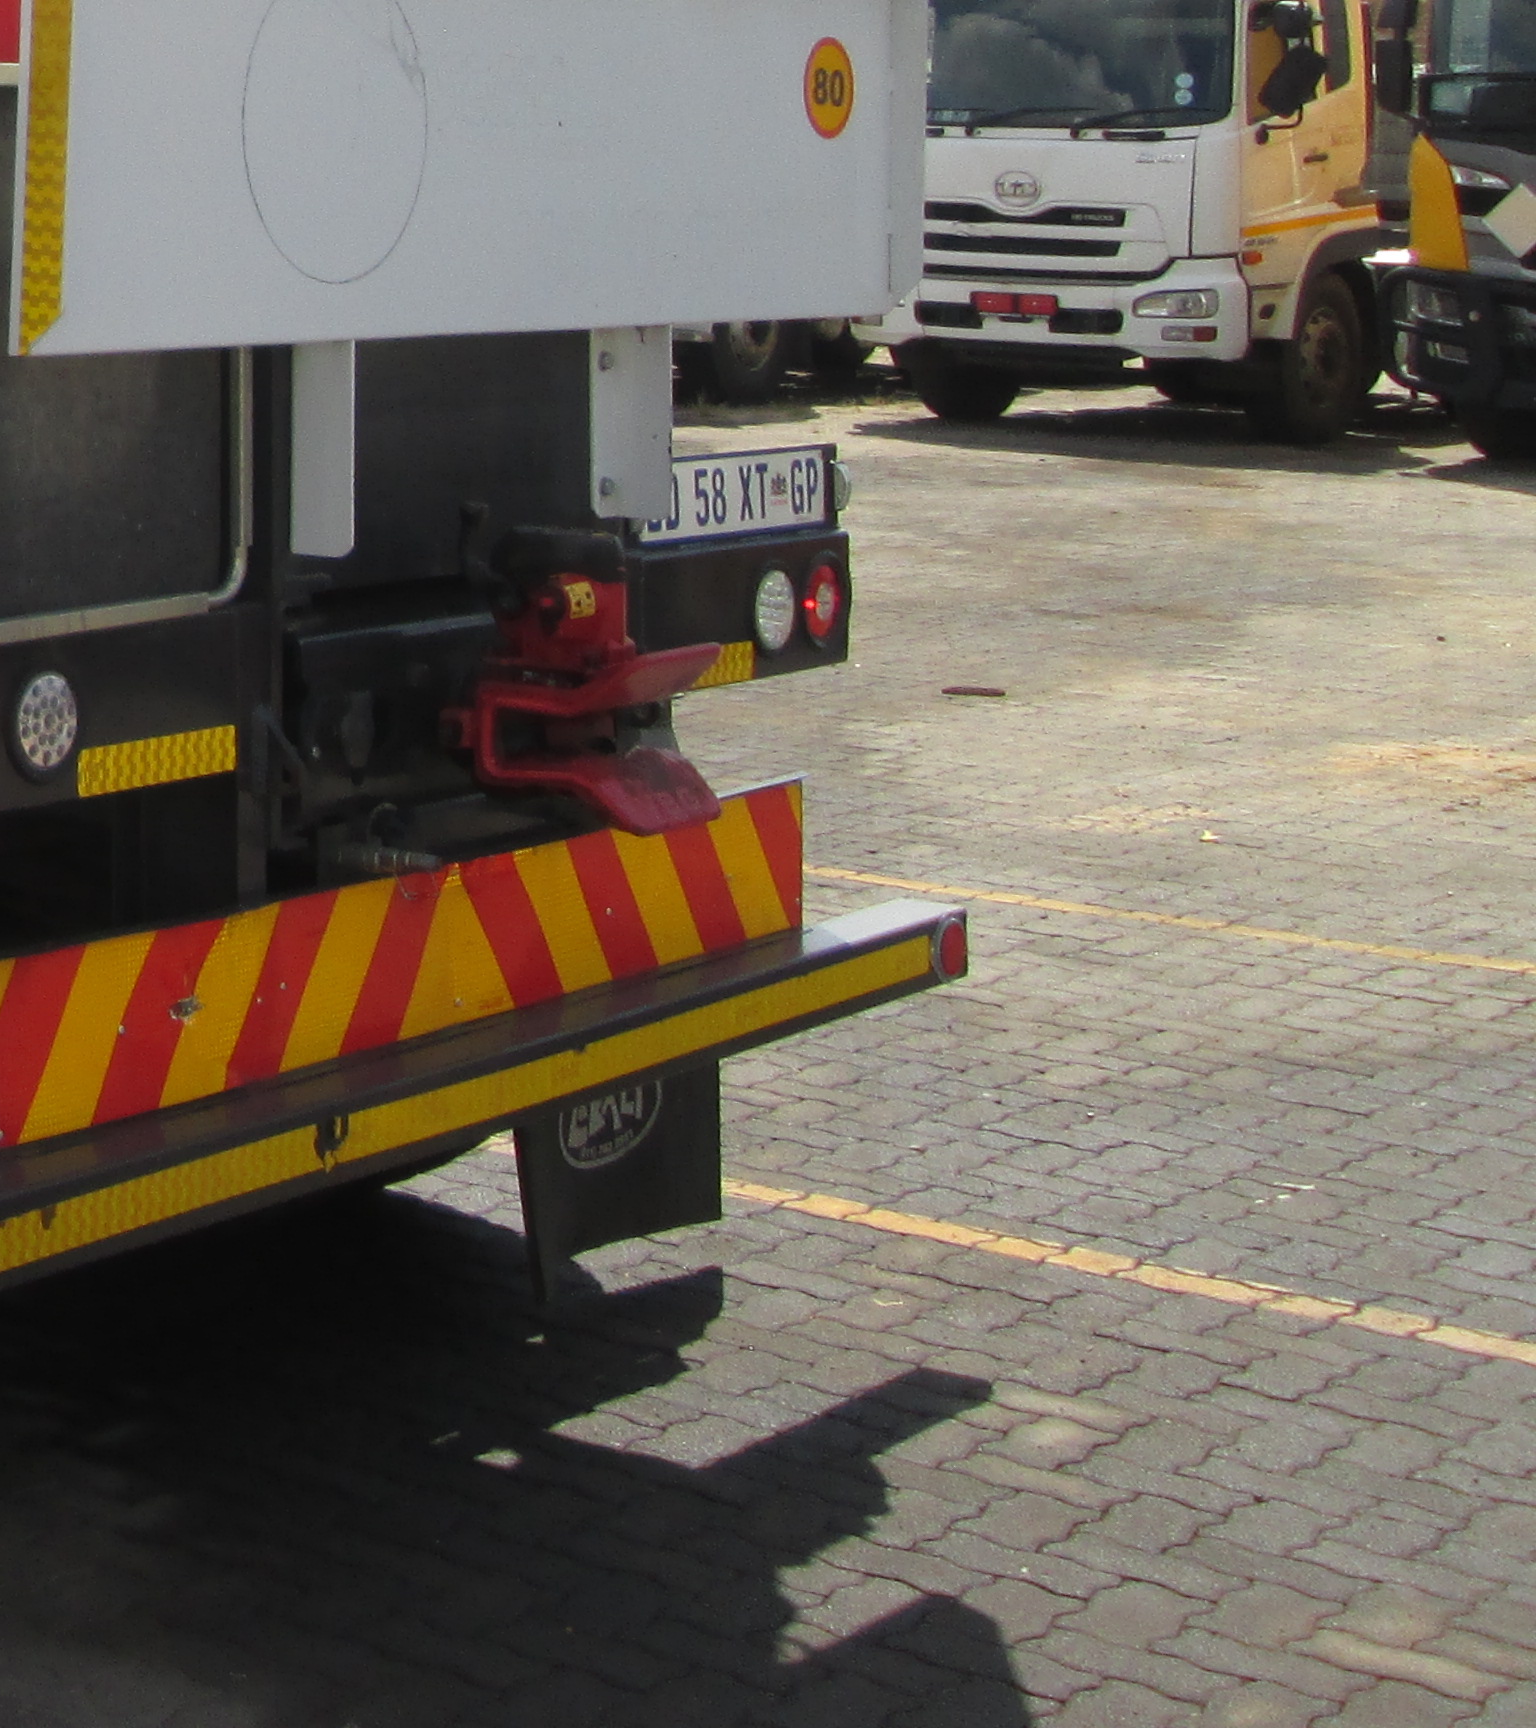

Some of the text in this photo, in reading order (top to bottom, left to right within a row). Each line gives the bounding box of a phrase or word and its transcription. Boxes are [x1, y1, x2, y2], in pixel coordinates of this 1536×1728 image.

[814, 67, 844, 107] 80
[693, 467, 728, 528] 58
[738, 463, 769, 522] XT
[790, 457, 819, 515] GP
